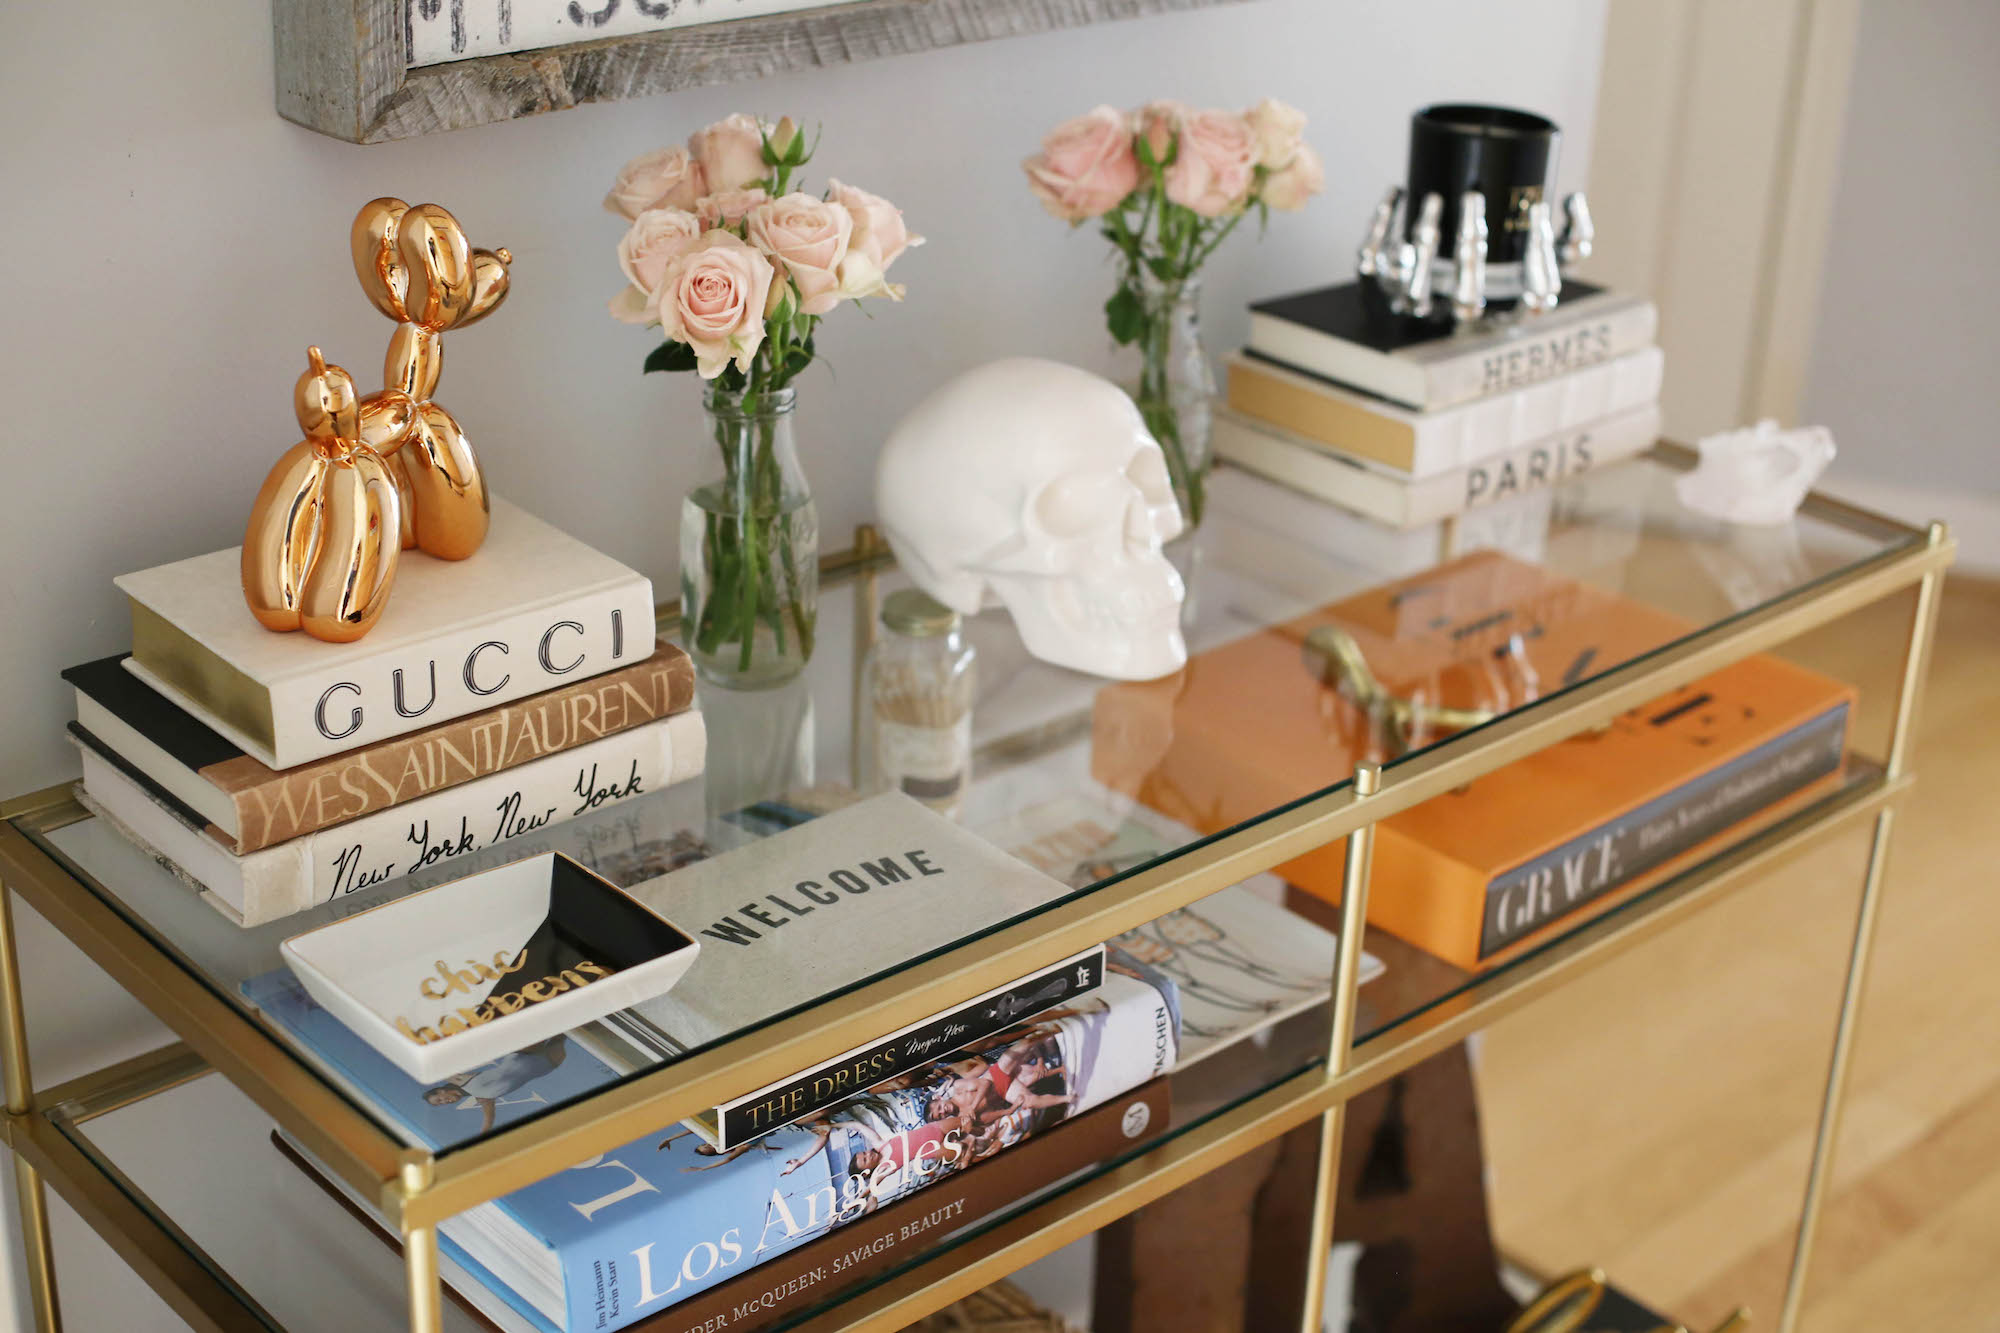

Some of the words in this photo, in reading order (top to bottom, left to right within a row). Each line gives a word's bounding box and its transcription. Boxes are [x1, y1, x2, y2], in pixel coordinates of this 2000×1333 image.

[1465, 435, 1594, 506] PARIS
[314, 610, 623, 740] GUCCI
[329, 844, 395, 902] New
[491, 791, 557, 843] New
[573, 759, 645, 816] York
[700, 850, 945, 946] WELCOME
[421, 949, 528, 999] chic
[746, 1088, 806, 1130] THE
[814, 1047, 897, 1102] DRESS
[629, 1227, 743, 1308] Los
[752, 1126, 963, 1254] Angeles
[832, 1232, 896, 1275] SAVAGE
[900, 1198, 967, 1241] BEAUTY
[608, 1260, 617, 1287] Starr
[609, 1288, 619, 1319] Kevin
